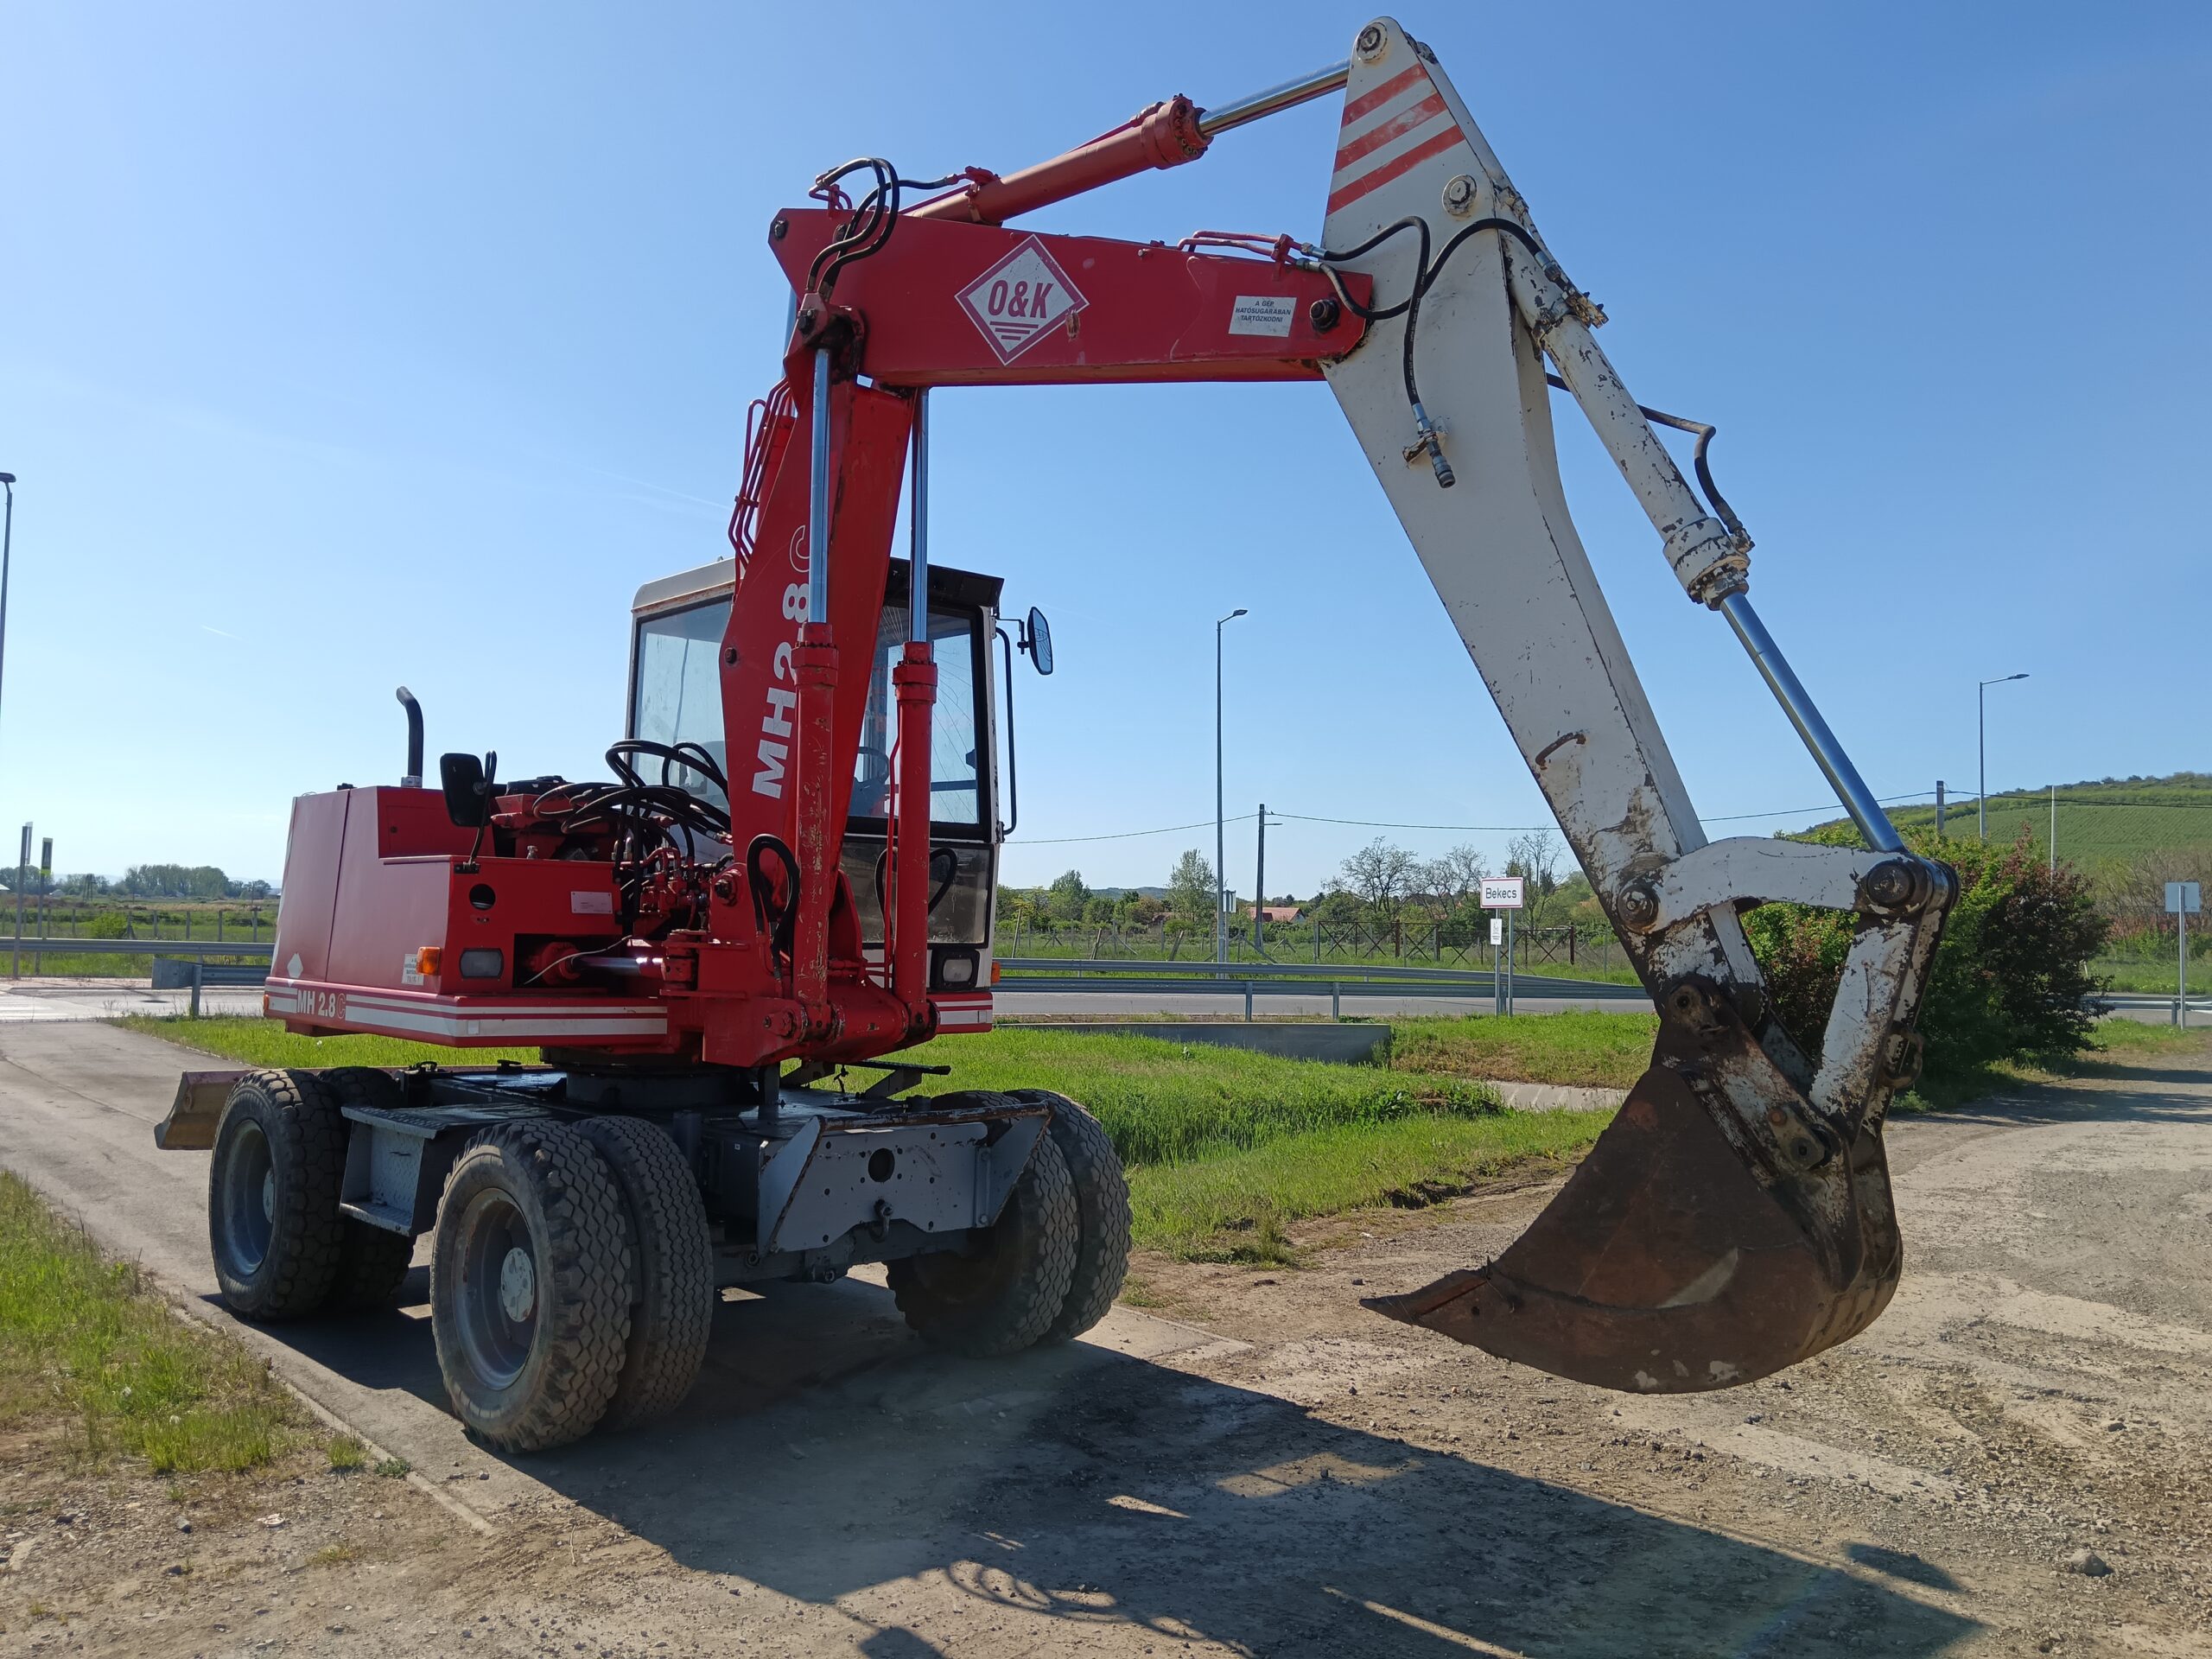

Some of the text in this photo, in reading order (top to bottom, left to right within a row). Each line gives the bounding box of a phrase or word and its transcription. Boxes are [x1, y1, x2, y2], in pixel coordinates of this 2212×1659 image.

[988, 279, 1054, 319] O&K
[1240, 315, 1284, 323] TARTÓZKODNI
[1485, 887, 1517, 899] Bekecs
[297, 989, 316, 1015] MH
